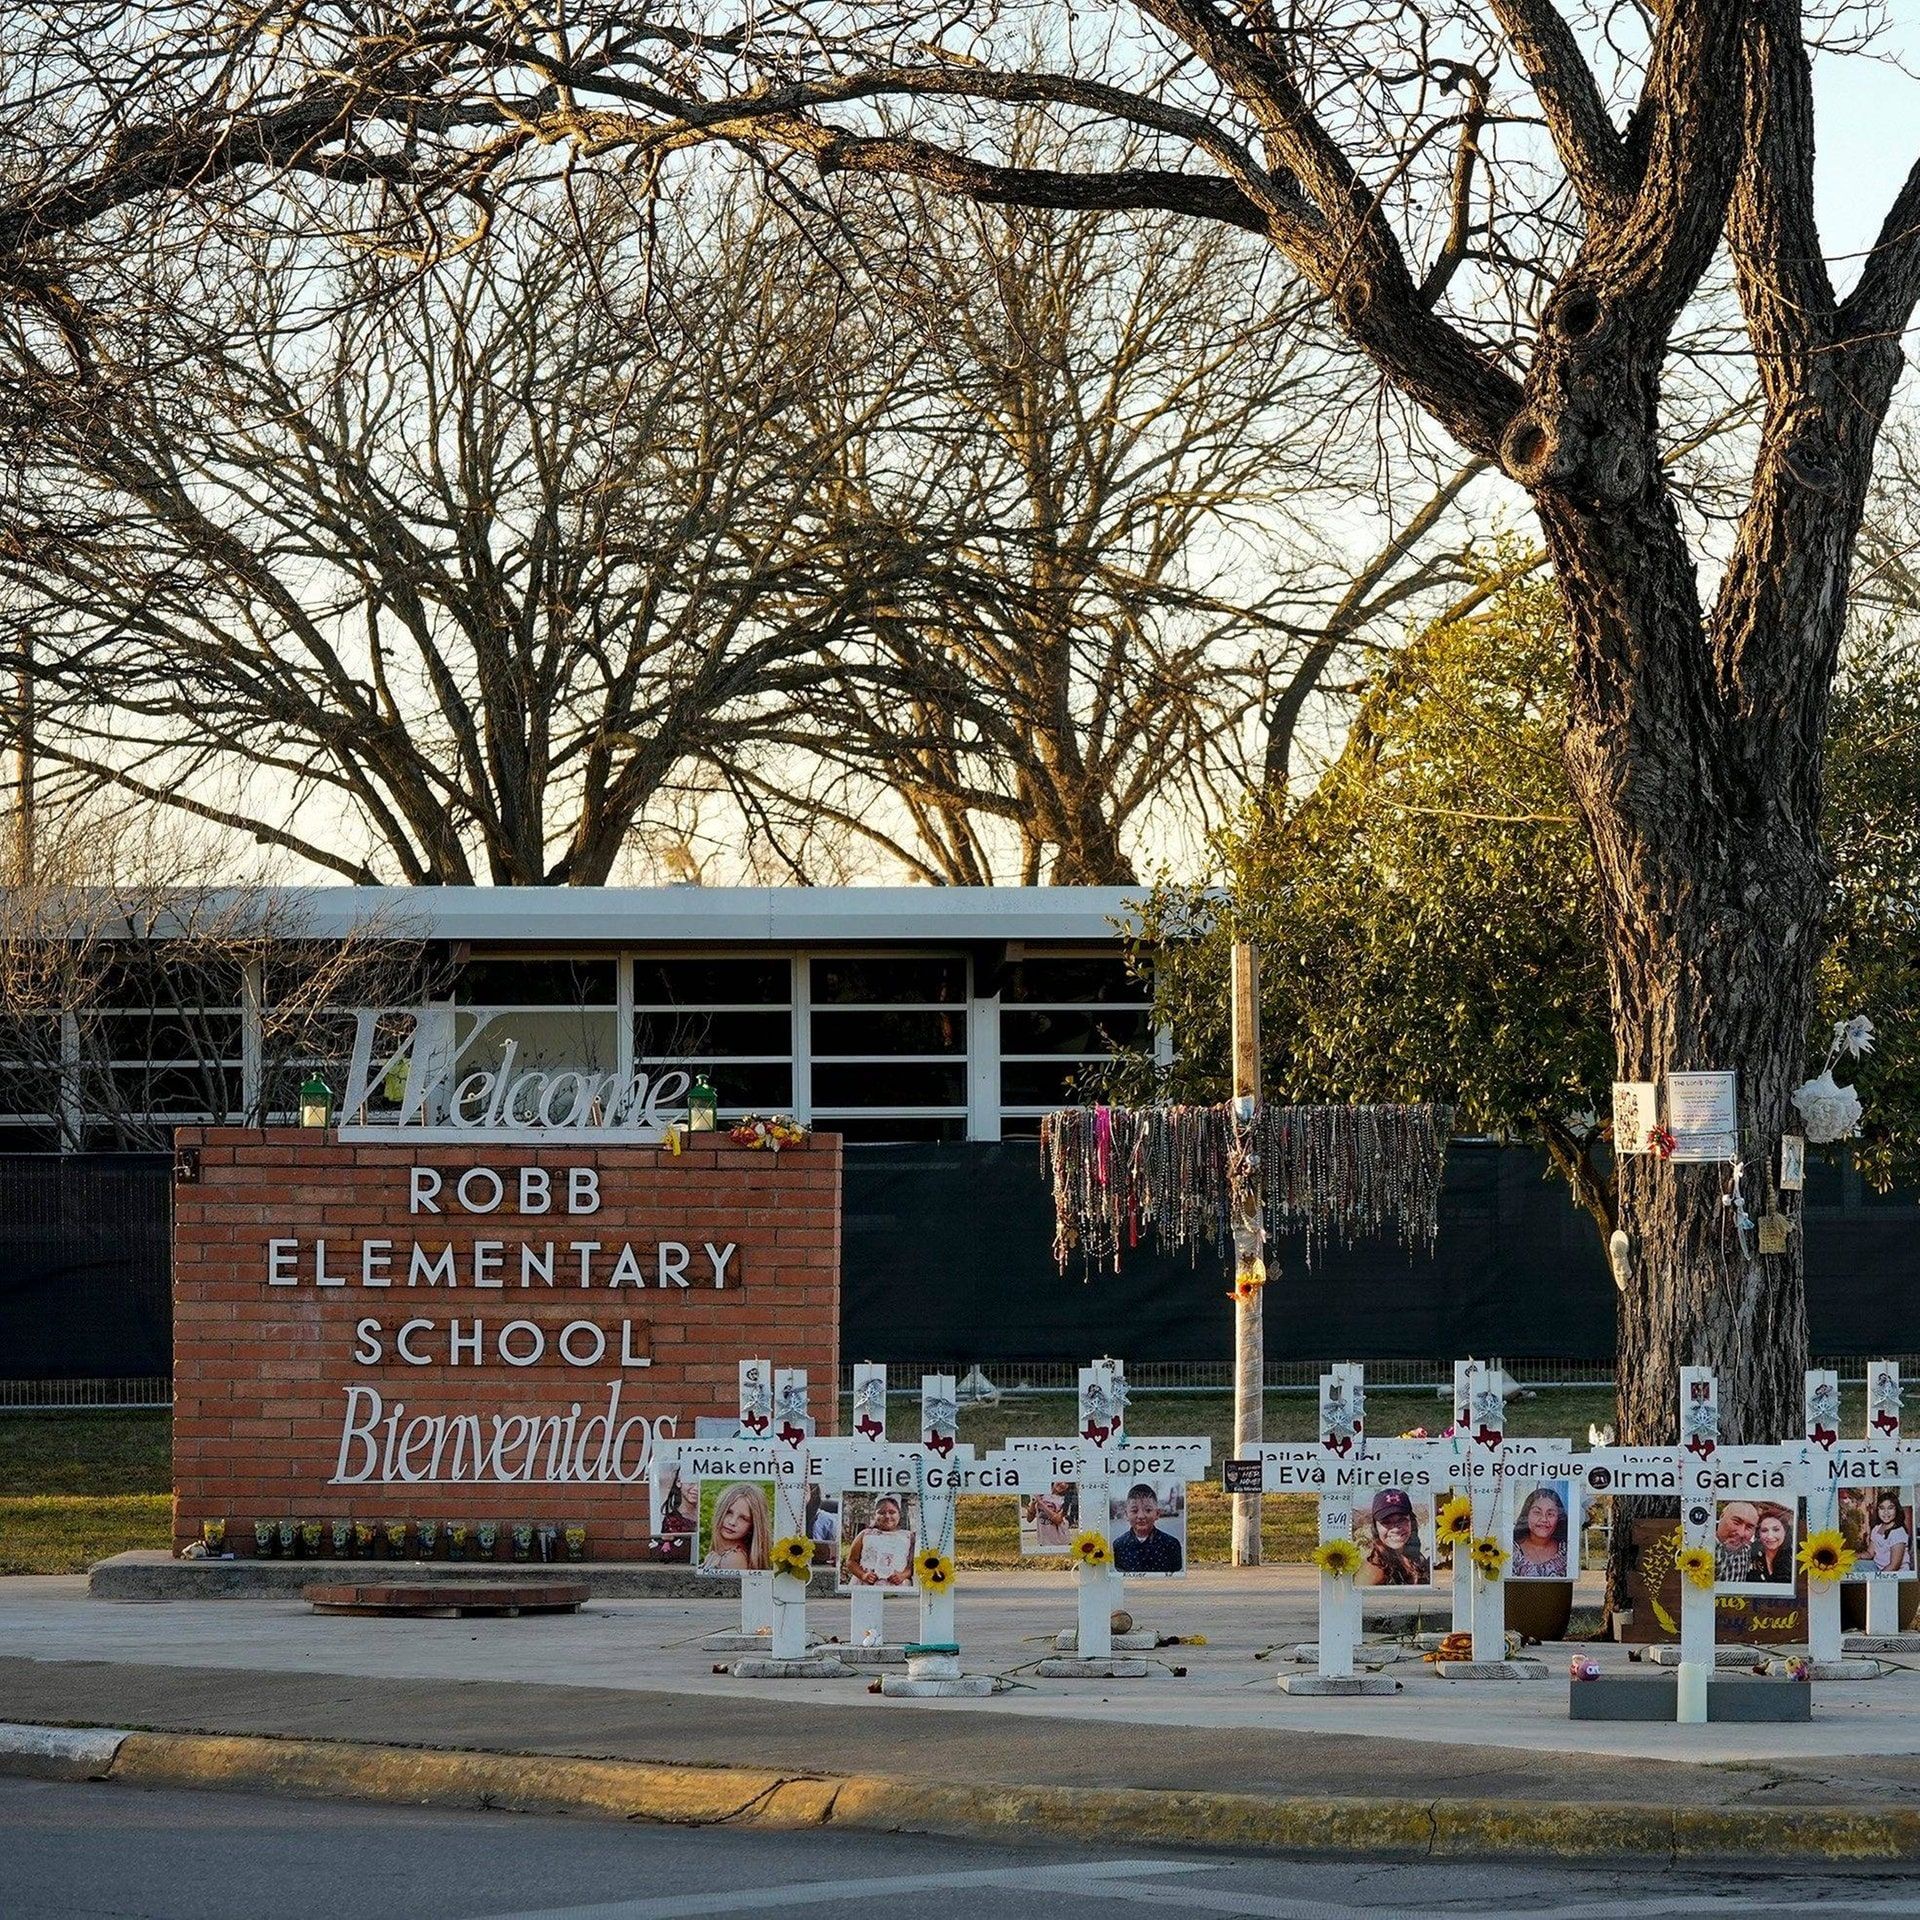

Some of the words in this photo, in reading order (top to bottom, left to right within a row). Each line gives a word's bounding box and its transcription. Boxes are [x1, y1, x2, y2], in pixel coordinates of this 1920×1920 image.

[340, 1008, 692, 1129] Welcome
[409, 1166, 601, 1216] ROBB
[267, 1239, 737, 1290] ELEMENTARY
[354, 1317, 652, 1368] SCHOOL
[692, 1458, 794, 1475] Makenna
[1104, 1457, 1176, 1477] Lopez
[1280, 1466, 1325, 1484] Eva
[1337, 1467, 1431, 1486] Mireles
[1492, 1463, 1584, 1480] Rodrigue
[1828, 1459, 1899, 1479] Mata
[854, 1466, 911, 1488] Ellie
[927, 1467, 1019, 1488] Garcia
[1614, 1469, 1675, 1488] Irma
[1696, 1469, 1784, 1489] Garcia
[1327, 1512, 1347, 1525] EVA
